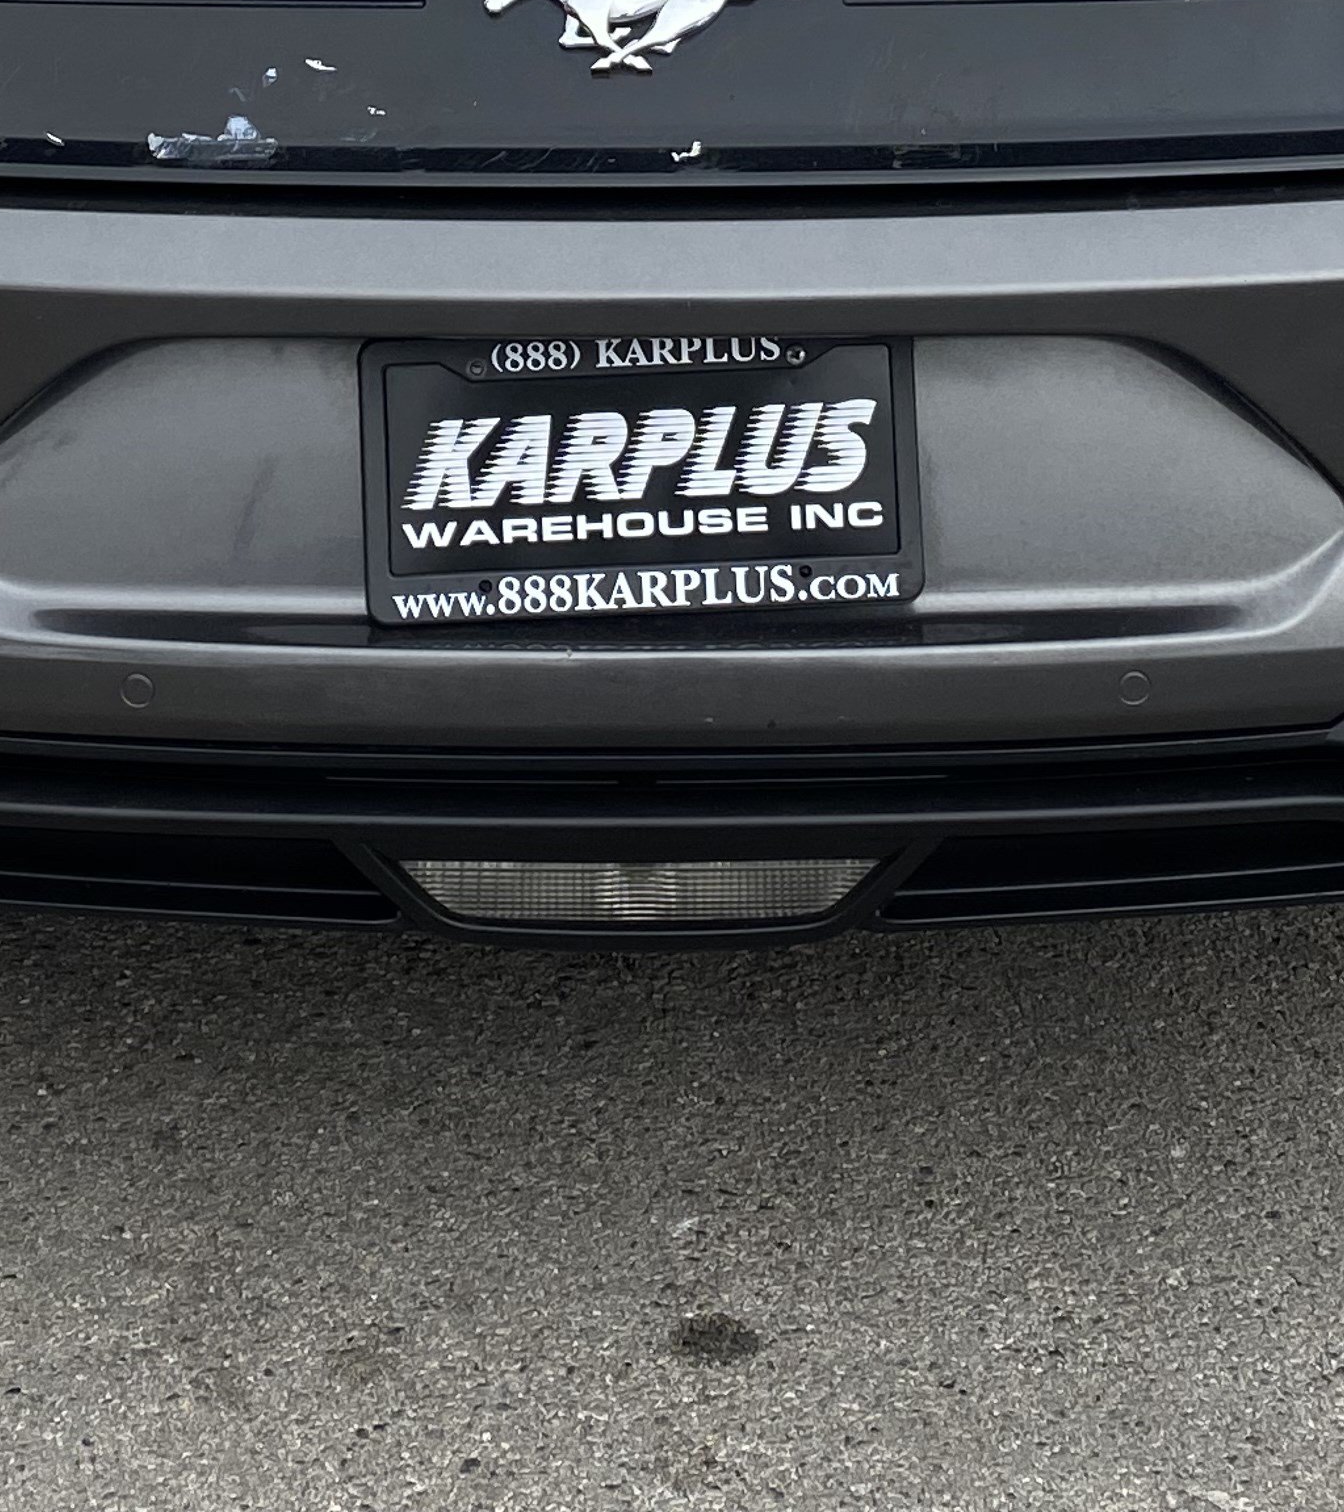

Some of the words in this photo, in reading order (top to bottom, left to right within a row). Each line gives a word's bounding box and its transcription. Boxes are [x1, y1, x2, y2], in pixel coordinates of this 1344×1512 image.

[490, 340, 581, 373] (888)
[595, 337, 781, 369] KARPLUS
[400, 398, 877, 511] KARPLUS
[401, 506, 770, 549] WAREHOUSE
[790, 501, 885, 532] INC
